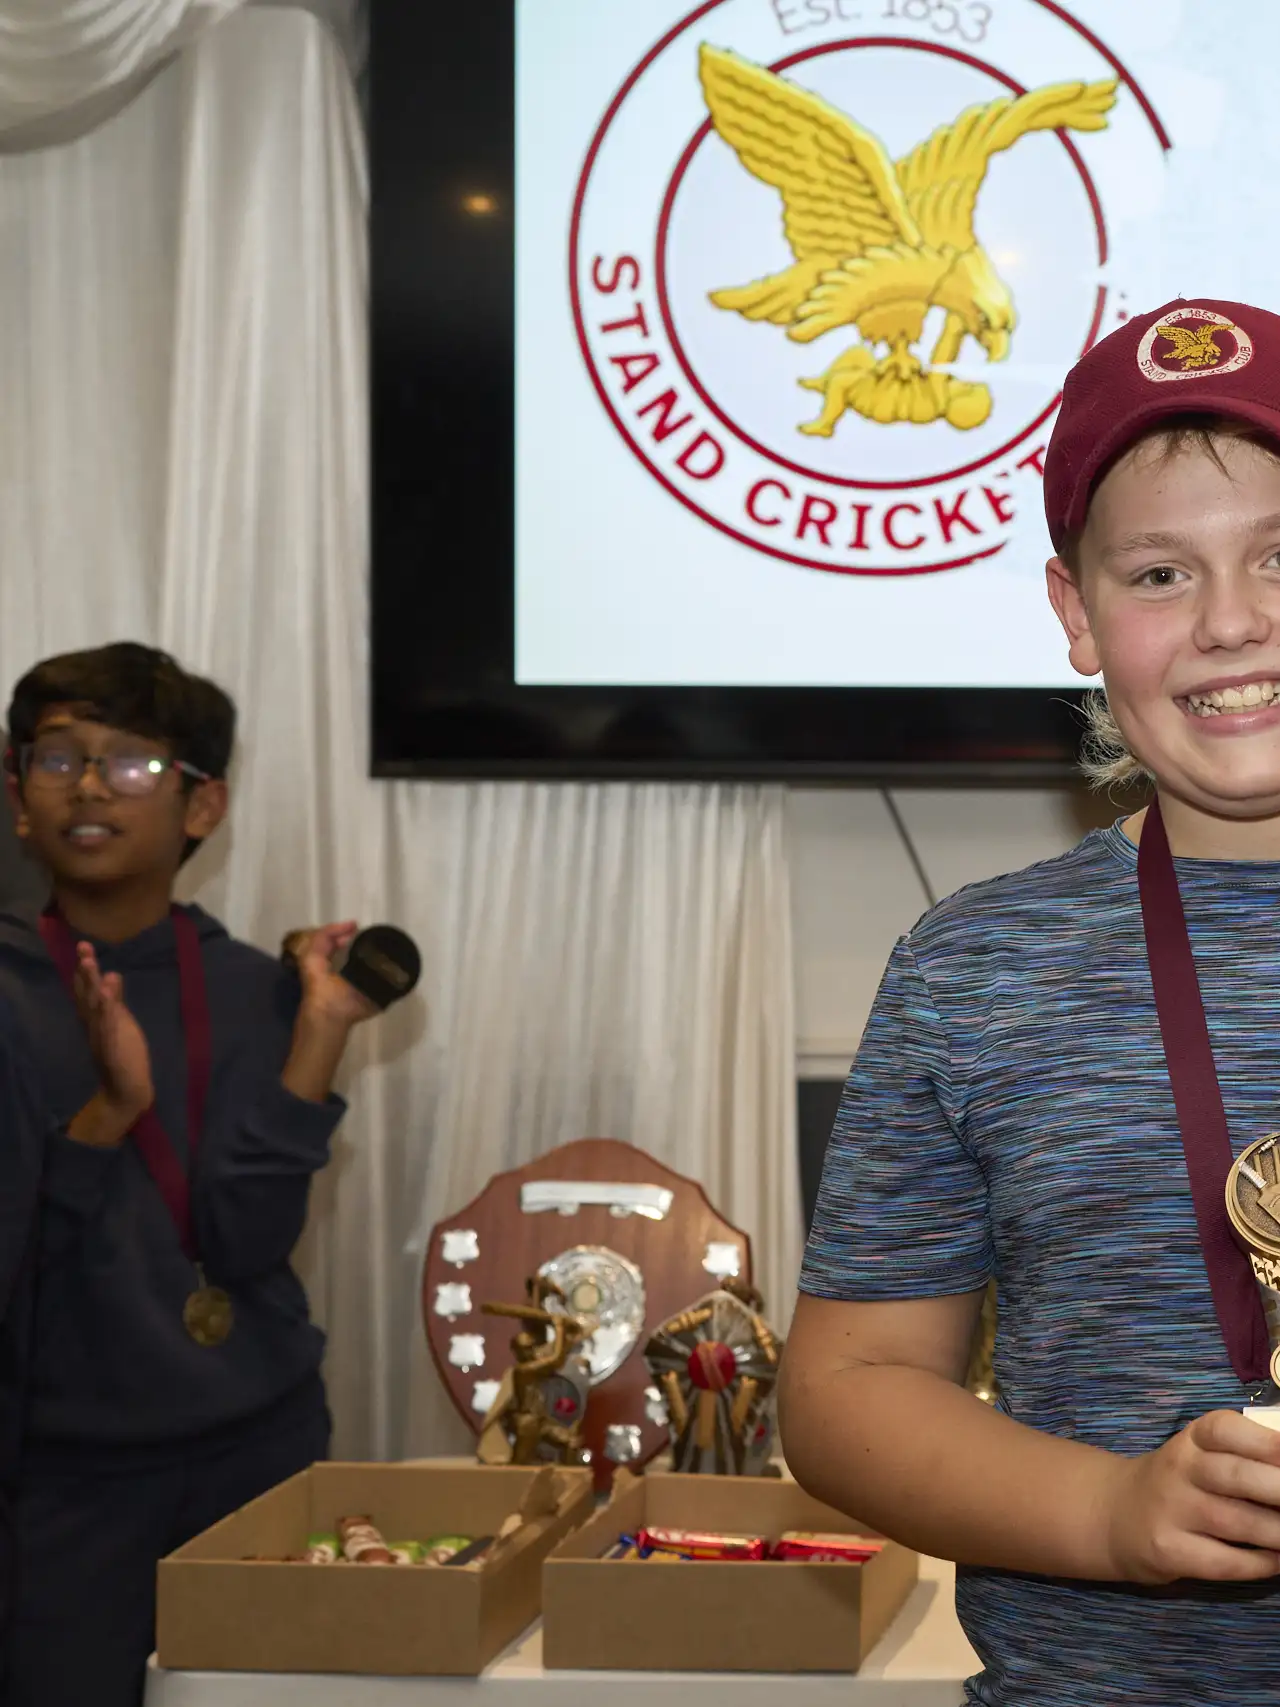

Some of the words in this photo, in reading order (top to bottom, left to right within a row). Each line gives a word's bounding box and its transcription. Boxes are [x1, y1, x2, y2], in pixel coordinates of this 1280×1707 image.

[592, 255, 726, 481] STAND
[1141, 360, 1167, 380] STAND
[1235, 346, 1251, 365] CLUB
